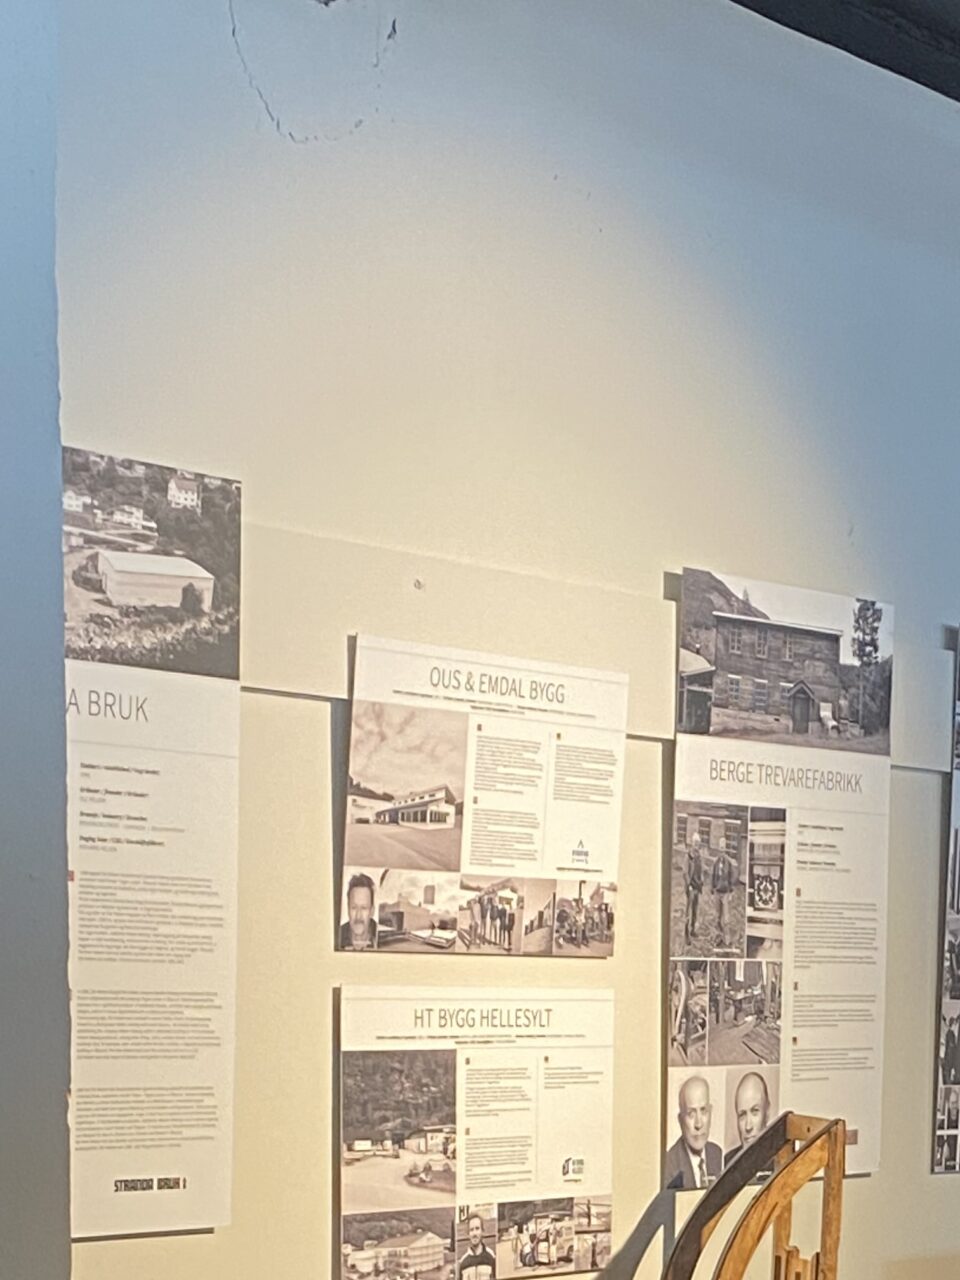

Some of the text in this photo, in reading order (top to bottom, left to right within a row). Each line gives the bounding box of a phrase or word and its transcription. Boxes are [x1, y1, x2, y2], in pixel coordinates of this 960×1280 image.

[430, 667, 461, 690] OUS
[464, 672, 476, 691] &
[478, 673, 525, 699] EMDAL
[529, 679, 565, 704] BYGG
[88, 690, 149, 722] BRUK
[710, 759, 863, 793] BERGE TREVAREFABRIKK
[414, 1008, 553, 1029] HT BYGG HELLESYLT
